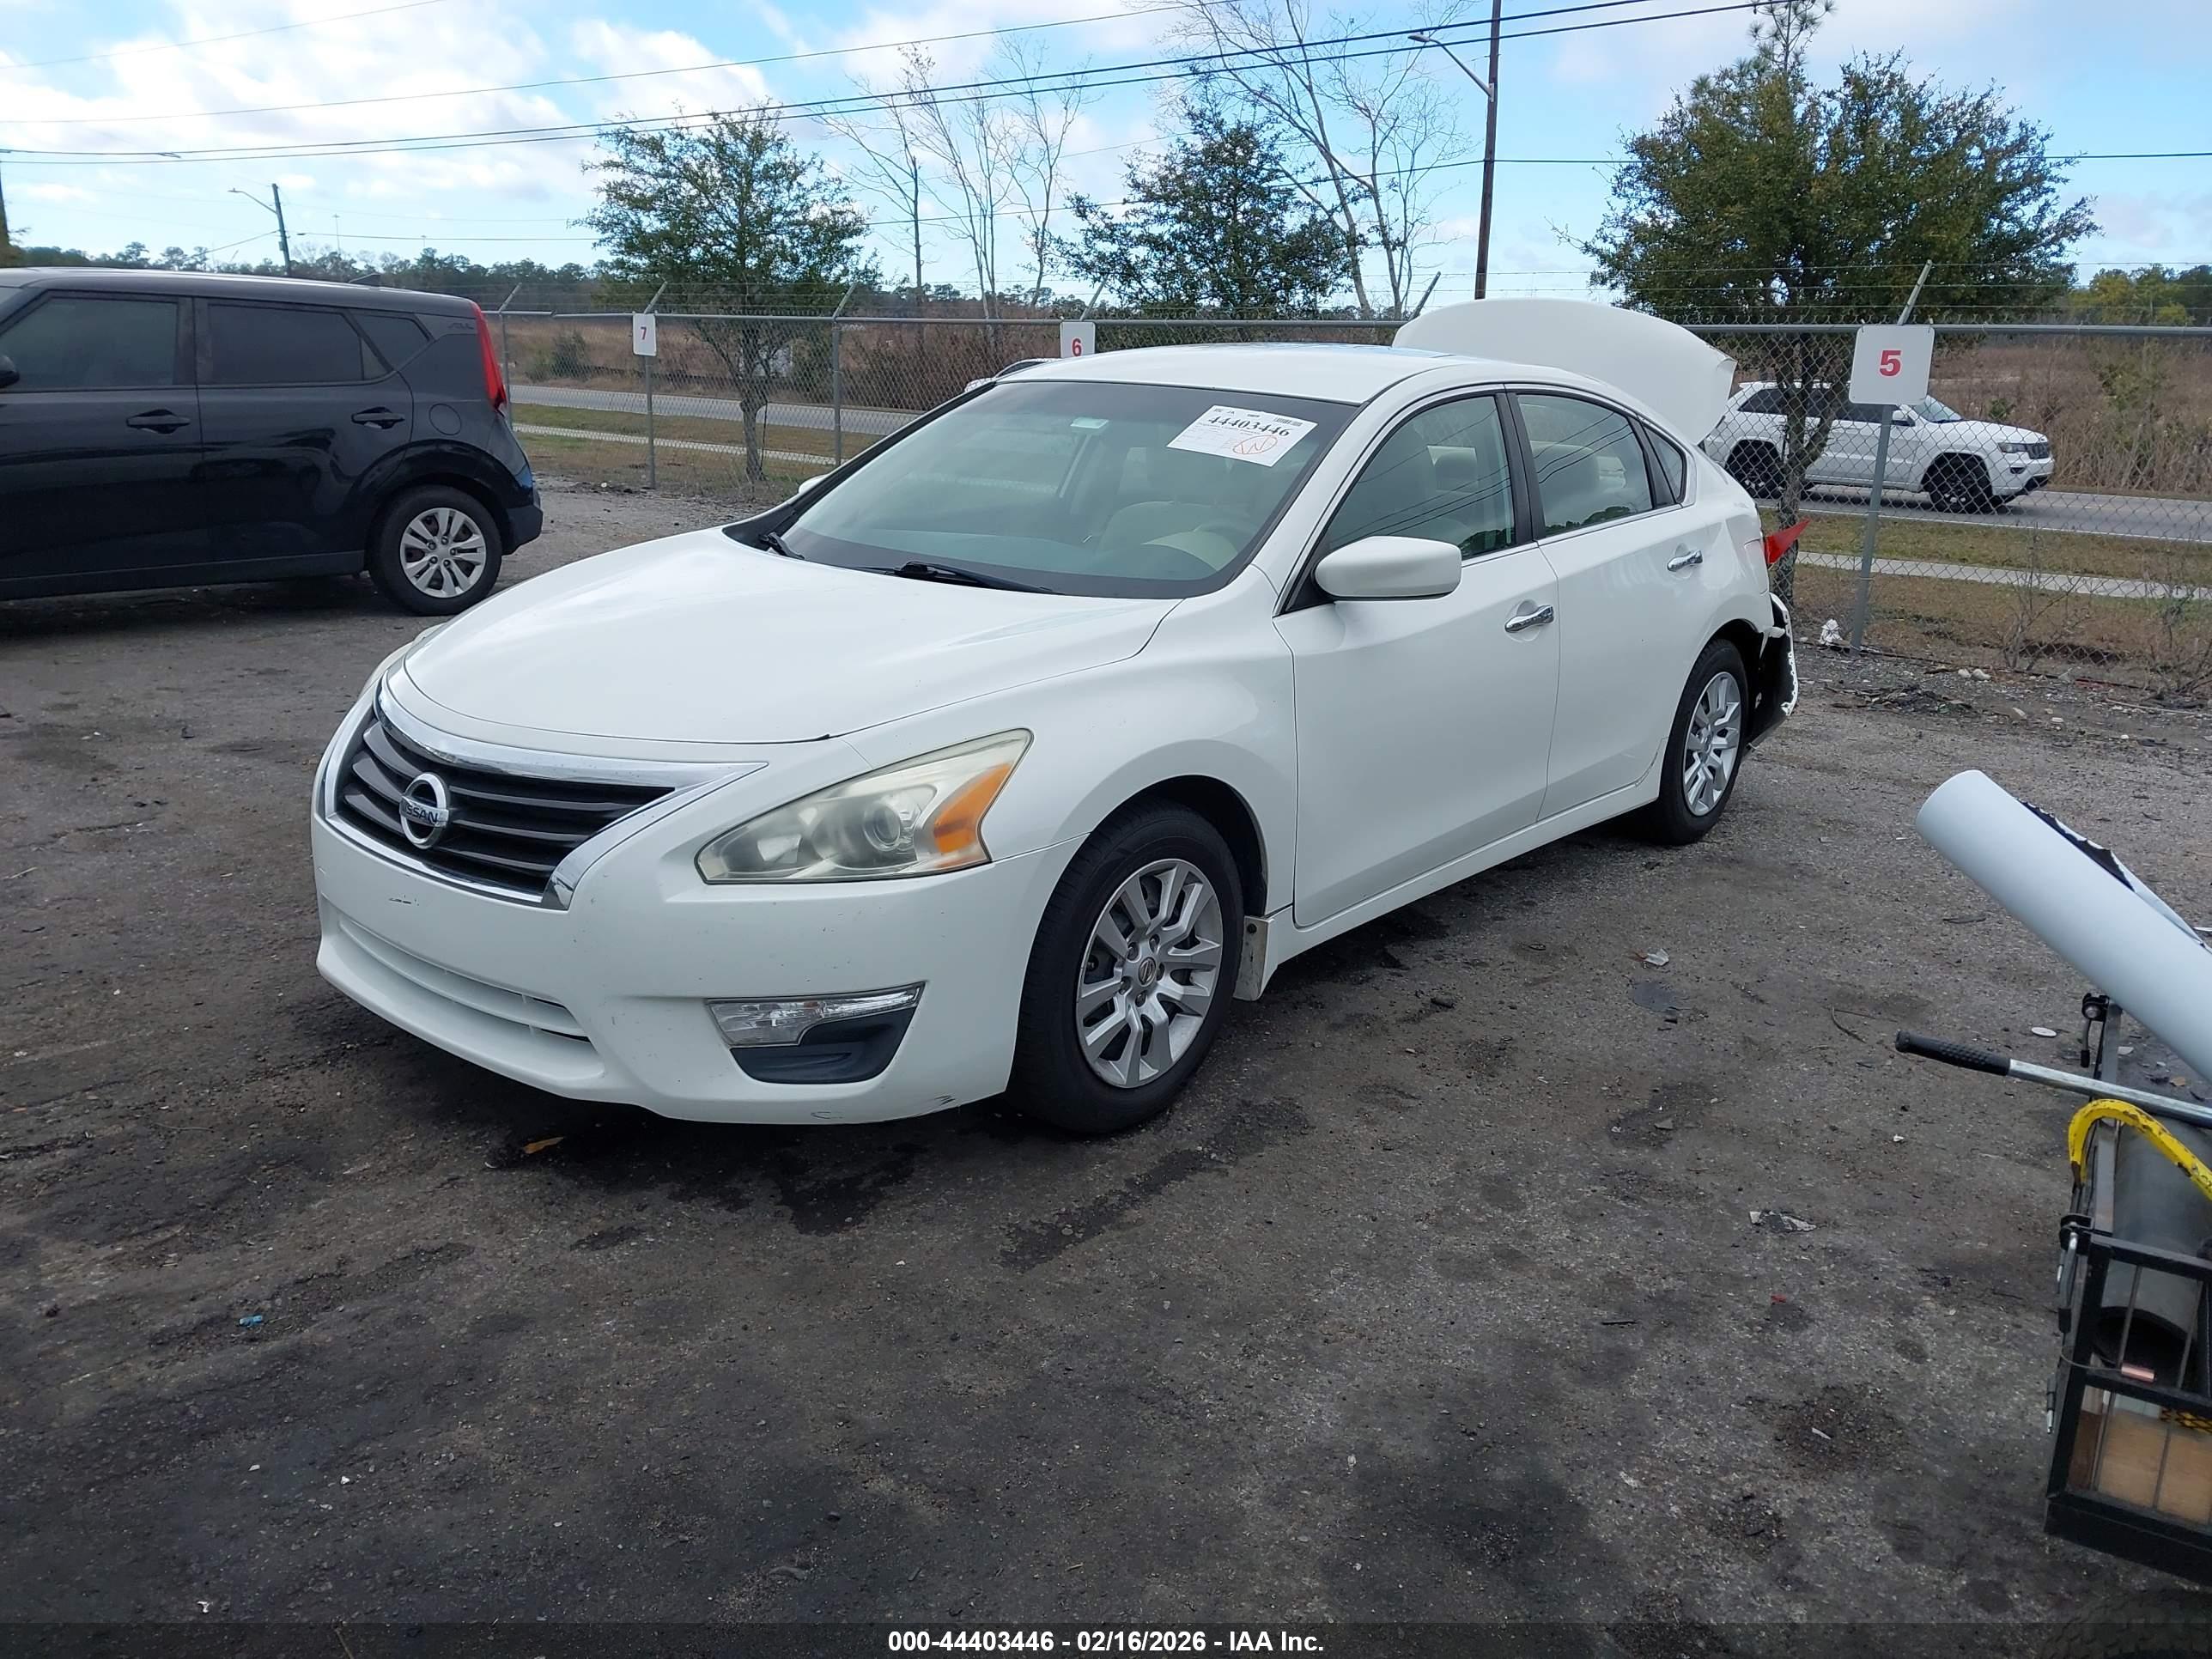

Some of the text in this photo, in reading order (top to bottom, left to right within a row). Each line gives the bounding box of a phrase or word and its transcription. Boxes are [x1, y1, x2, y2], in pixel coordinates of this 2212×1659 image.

[641, 326, 647, 340] 7
[1072, 337, 1082, 357] 6
[1879, 349, 1902, 377] 5
[1208, 416, 1290, 437] 44403446
